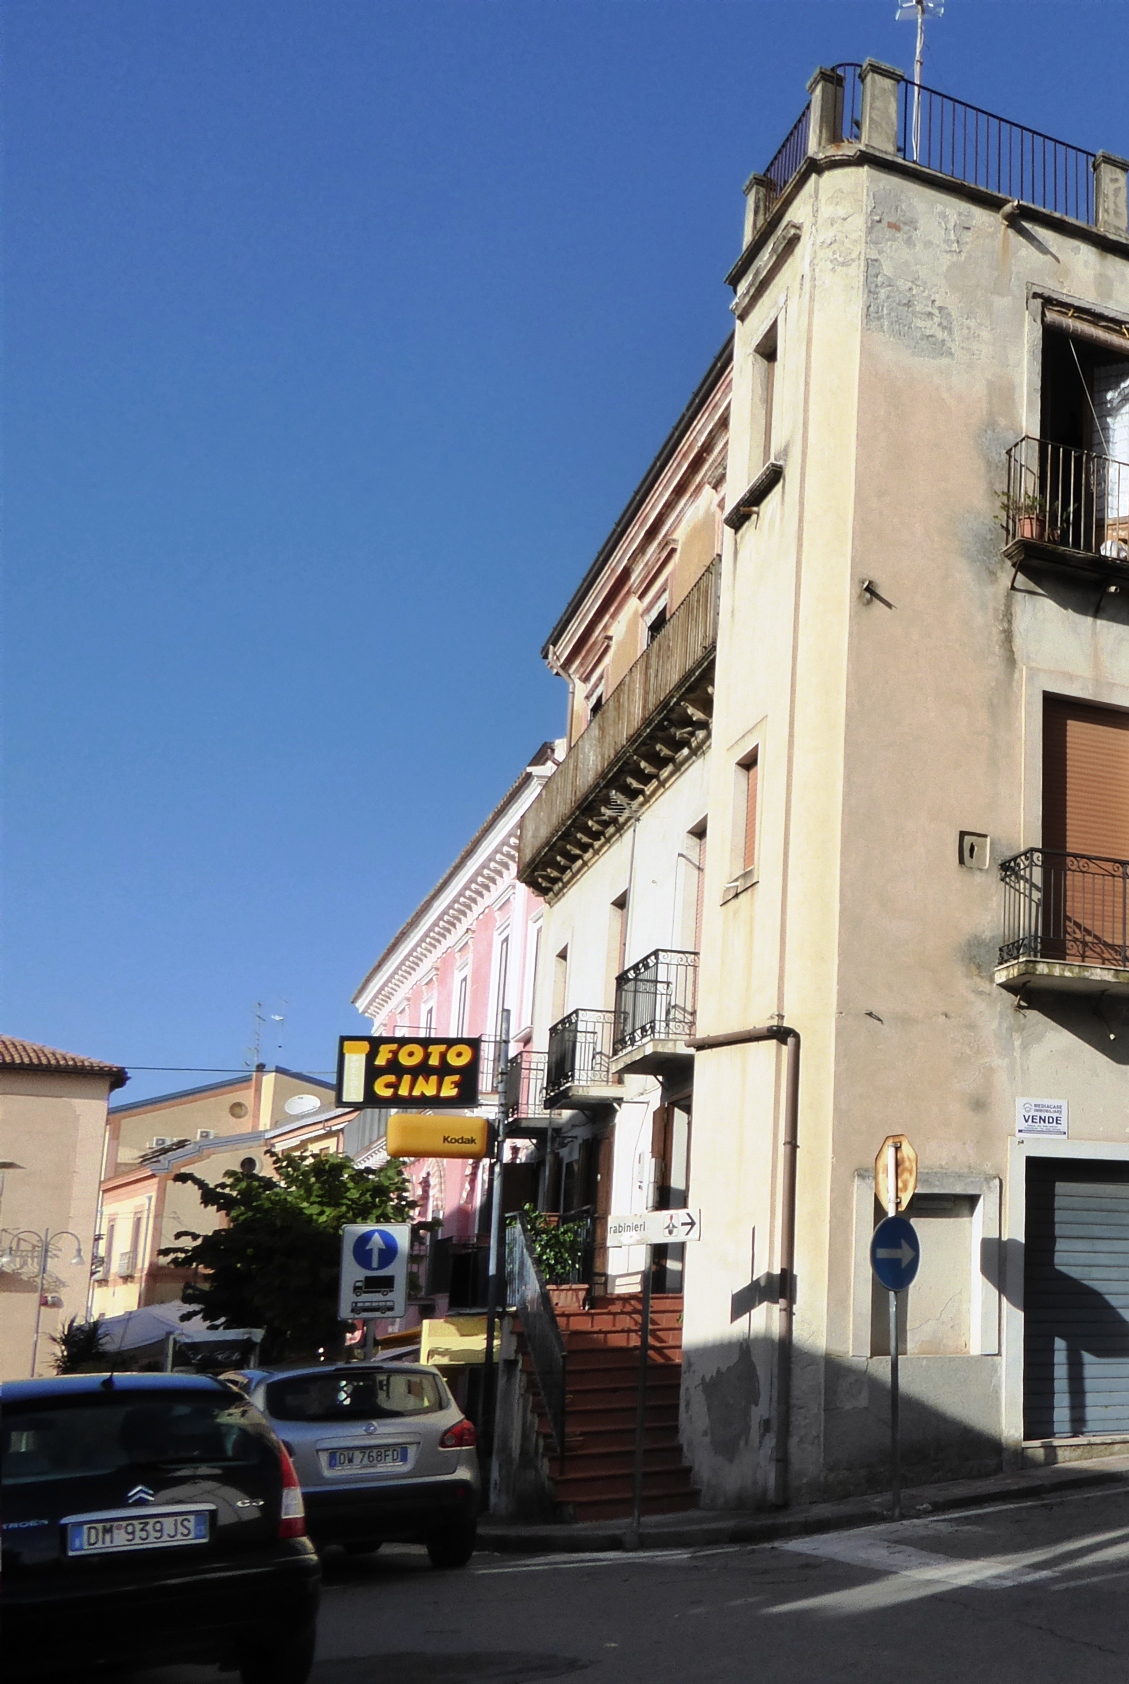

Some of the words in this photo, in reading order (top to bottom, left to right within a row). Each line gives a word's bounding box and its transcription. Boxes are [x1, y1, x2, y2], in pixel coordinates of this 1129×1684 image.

[374, 1043, 474, 1068] FOTO
[373, 1073, 463, 1099] CINE
[1023, 1114, 1062, 1125] VENDE
[442, 1135, 477, 1145] Kodak
[609, 1221, 646, 1234] rabinieri
[338, 1452, 354, 1465] DW
[359, 1448, 399, 1464] 768FD
[86, 1524, 114, 1547] DM
[124, 1517, 193, 1542] 939JS
